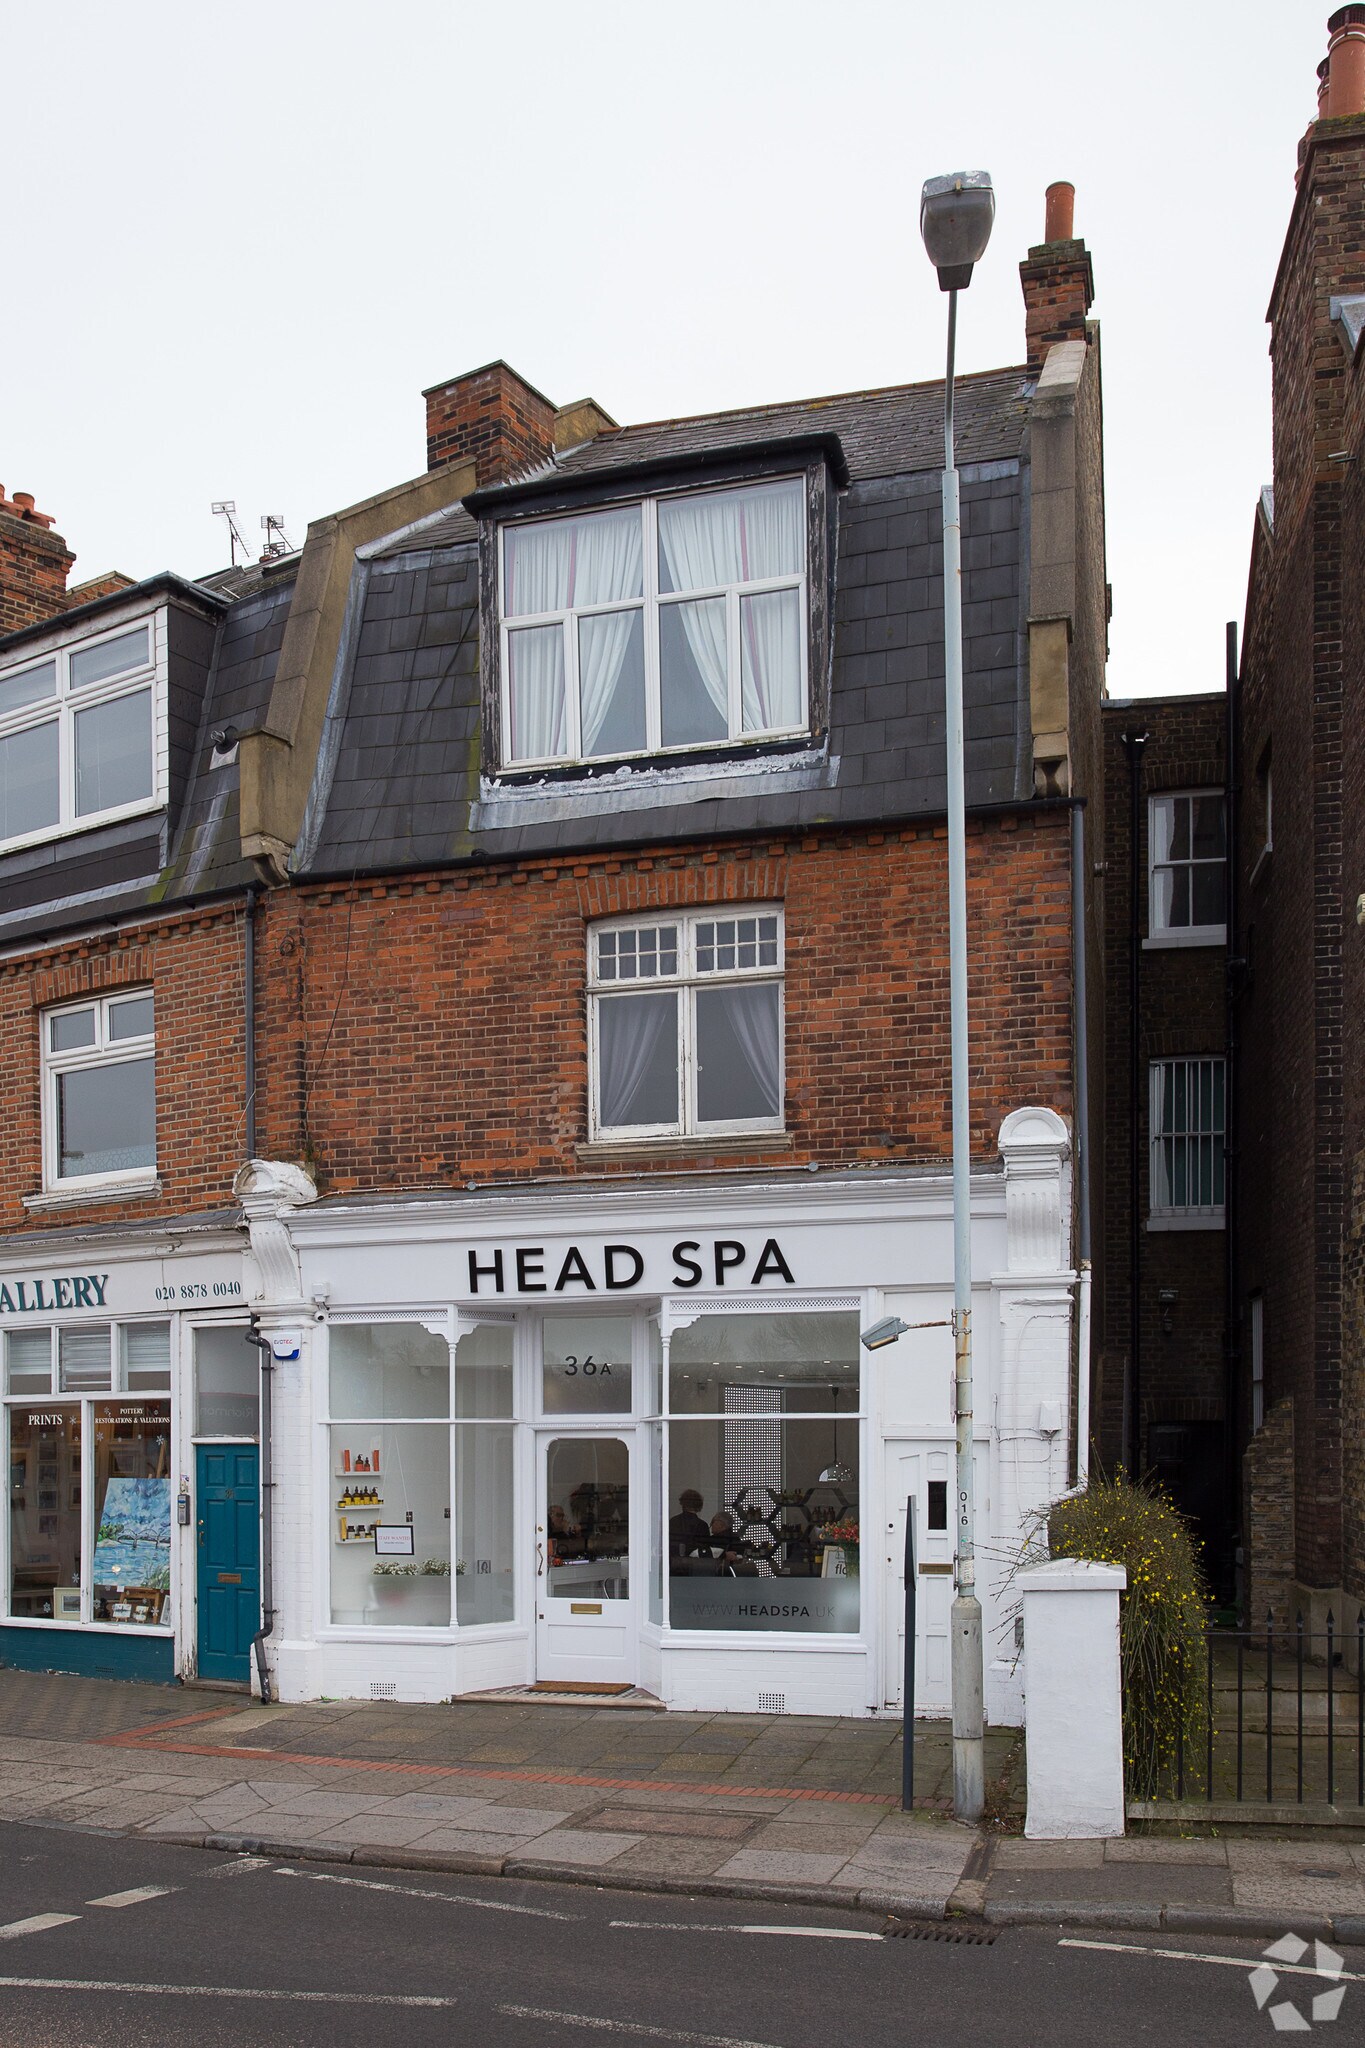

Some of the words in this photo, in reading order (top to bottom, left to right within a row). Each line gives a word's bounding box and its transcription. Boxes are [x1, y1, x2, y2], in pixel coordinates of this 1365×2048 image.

[468, 1244, 645, 1293] HEAD
[672, 1238, 796, 1288] SPA
[0, 1274, 109, 1313] ALLERY
[155, 1286, 176, 1301] 020
[180, 1283, 208, 1299] 8878
[213, 1280, 241, 1297] 0040
[28, 1414, 63, 1426] PRINTS
[120, 1407, 144, 1415] POTTERY
